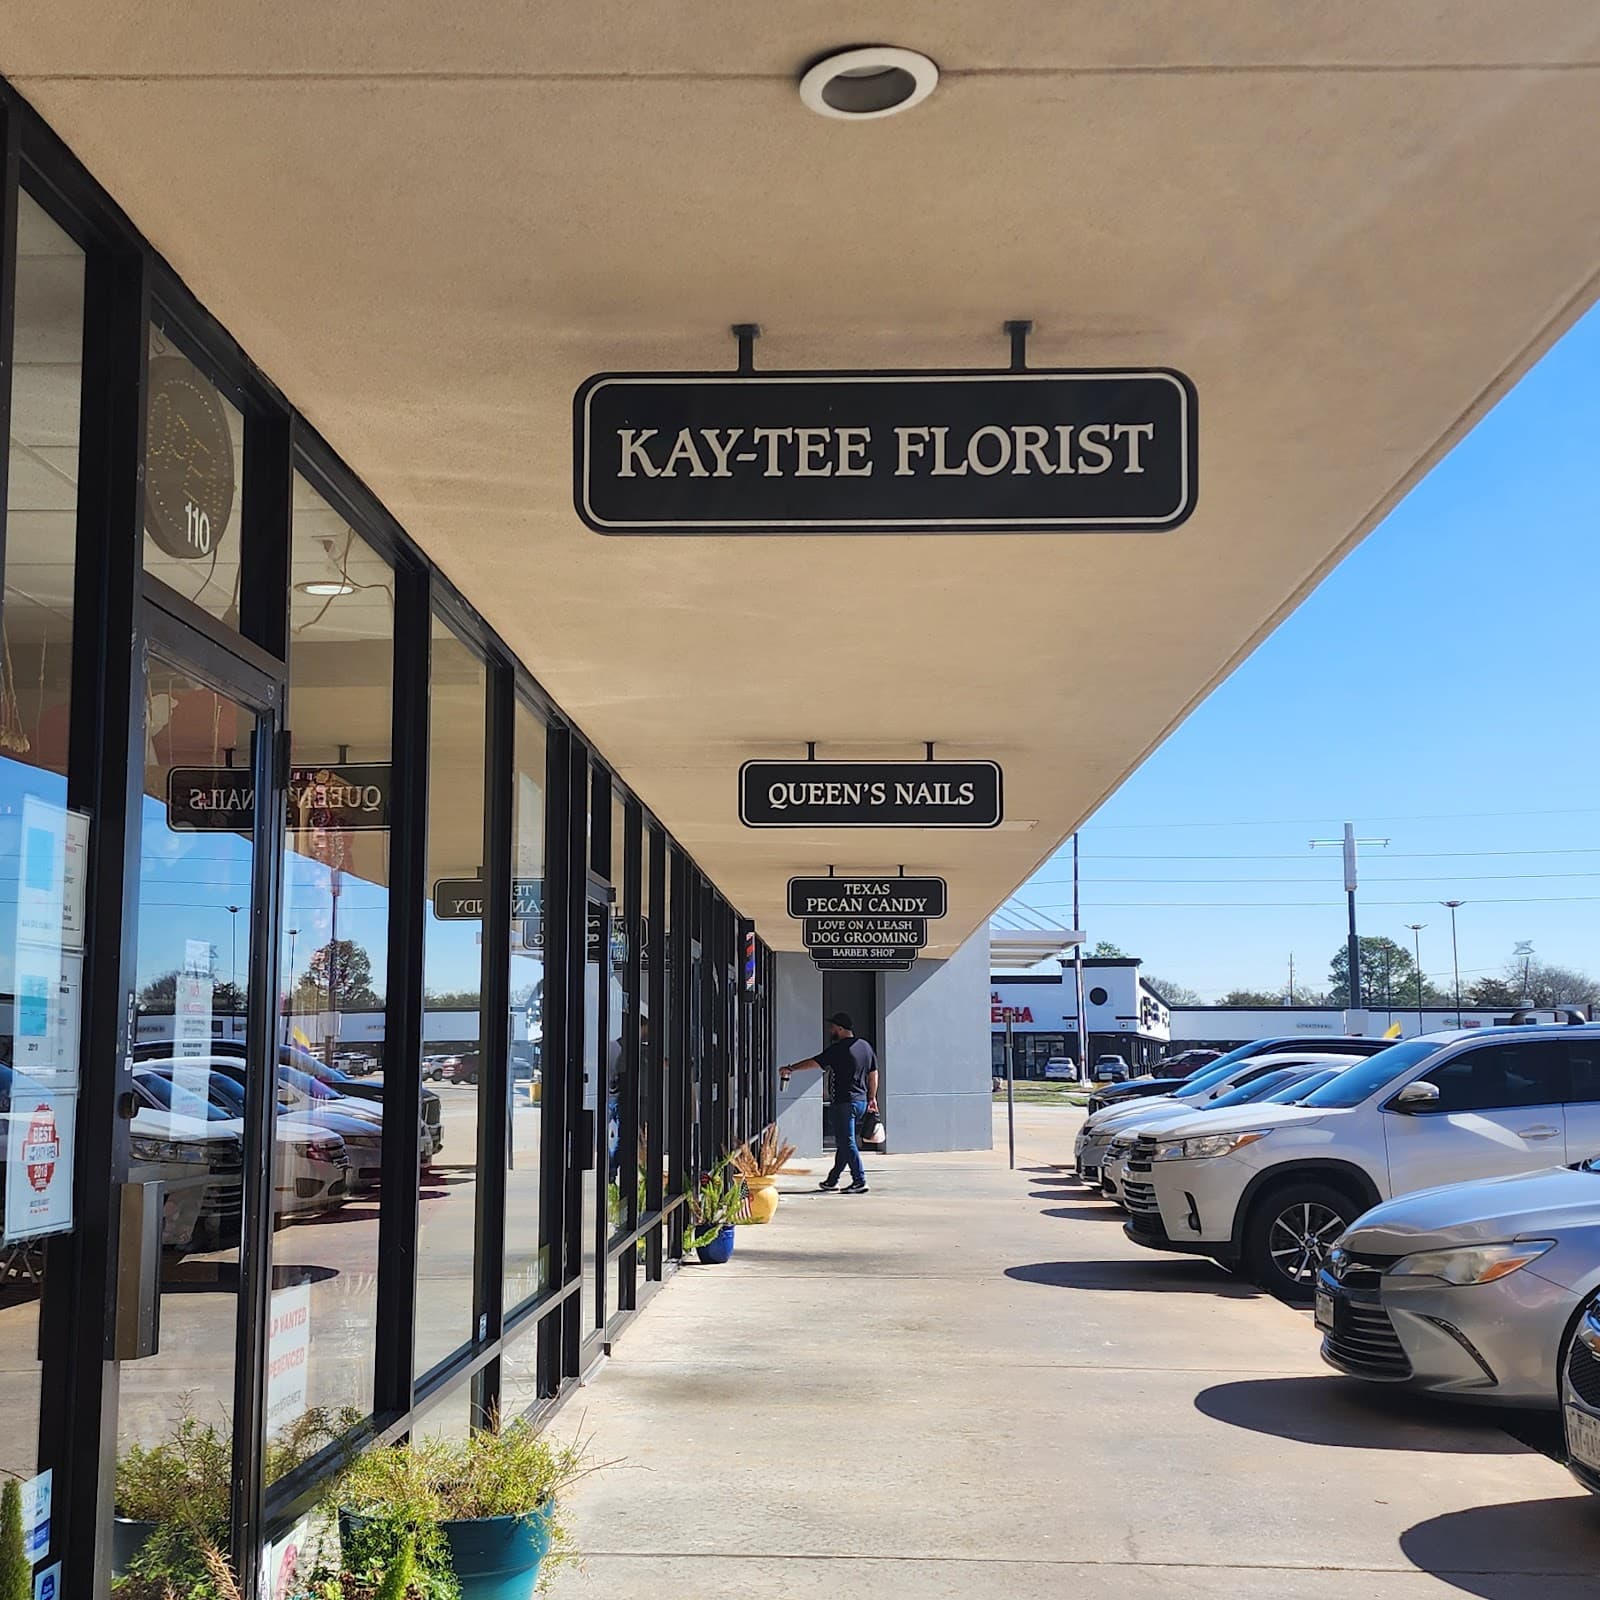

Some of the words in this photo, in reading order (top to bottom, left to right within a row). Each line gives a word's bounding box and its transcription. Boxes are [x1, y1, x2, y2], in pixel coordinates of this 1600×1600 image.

[616, 427, 873, 478] KAY-TEE
[893, 422, 1154, 476] FLORIST
[185, 501, 210, 554] 110
[768, 783, 886, 809] QUEEN'S
[895, 783, 975, 805] NAILS
[844, 884, 890, 895] TEXAS
[806, 898, 862, 912] PECAN
[868, 898, 927, 912] CANDY
[818, 920, 846, 930] LOVE
[848, 920, 864, 930] ON
[866, 920, 875, 930] A
[877, 920, 913, 930] LEASH
[812, 932, 840, 944] DOG
[844, 932, 918, 944] GROOMING
[832, 948, 868, 957] BARBER
[870, 948, 895, 957] SHOP
[33, 1126, 53, 1143] BEST
